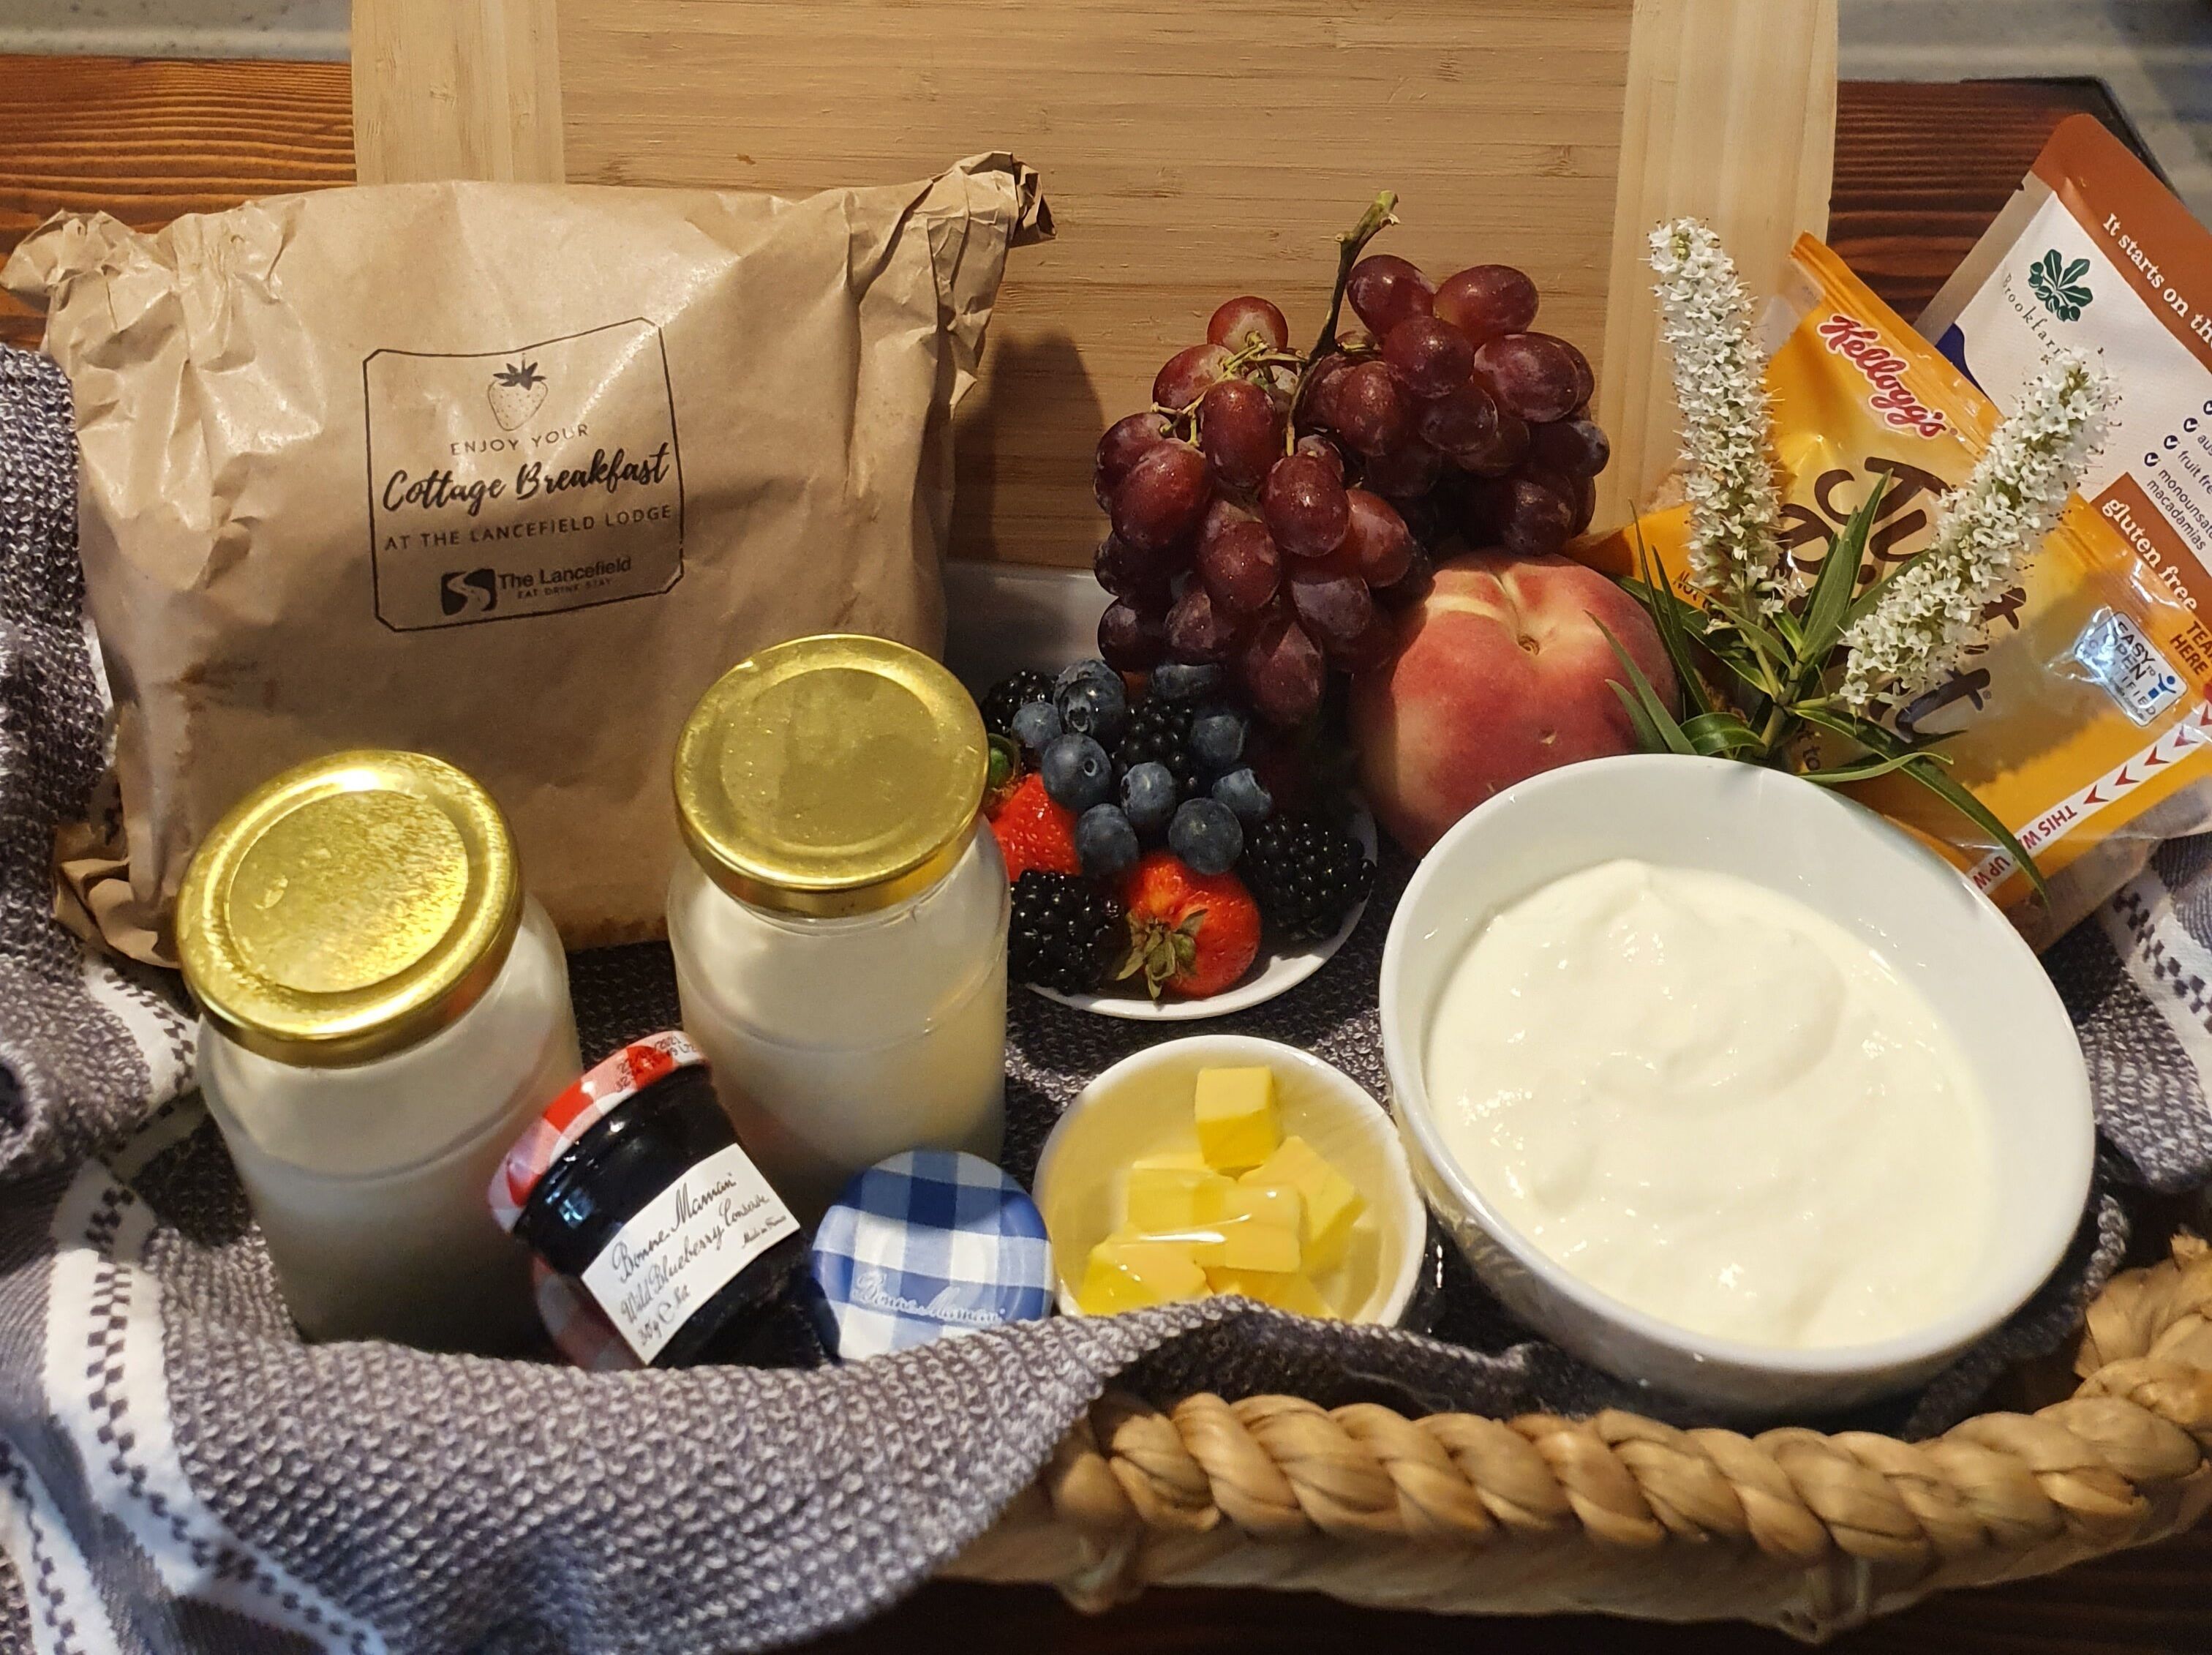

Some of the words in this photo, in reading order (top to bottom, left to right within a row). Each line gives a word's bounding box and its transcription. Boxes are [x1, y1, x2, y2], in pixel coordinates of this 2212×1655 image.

[2103, 213, 2121, 236] It
[2118, 234, 2164, 288] starts
[2163, 288, 2189, 318] on
[2190, 314, 2212, 350] th
[1818, 315, 1947, 438] Kellogg's
[451, 438, 519, 456] ENJOY
[531, 424, 588, 448] YOUR
[383, 468, 506, 517] Cottage
[516, 442, 669, 500] Breakfast
[2178, 450, 2200, 477] fruit
[384, 535, 410, 551] AT
[421, 531, 460, 547] THE
[470, 516, 595, 543] LANCEFIELD
[605, 505, 672, 527] LODGE
[2147, 480, 2205, 550] macadamias
[498, 573, 535, 589] The
[540, 556, 631, 584] Lancefield
[2102, 499, 2161, 568] gluten
[2159, 566, 2197, 612] free
[518, 588, 538, 599] EAT
[2170, 634, 2209, 675] HERE
[2186, 620, 2212, 660] TEA
[2038, 805, 2077, 837] THIS
[1989, 855, 2010, 877] UP
[612, 1229, 670, 1284] Bonne
[671, 1174, 737, 1233] Maman
[622, 1278, 652, 1325] Wild
[648, 1225, 725, 1294] Blueberry
